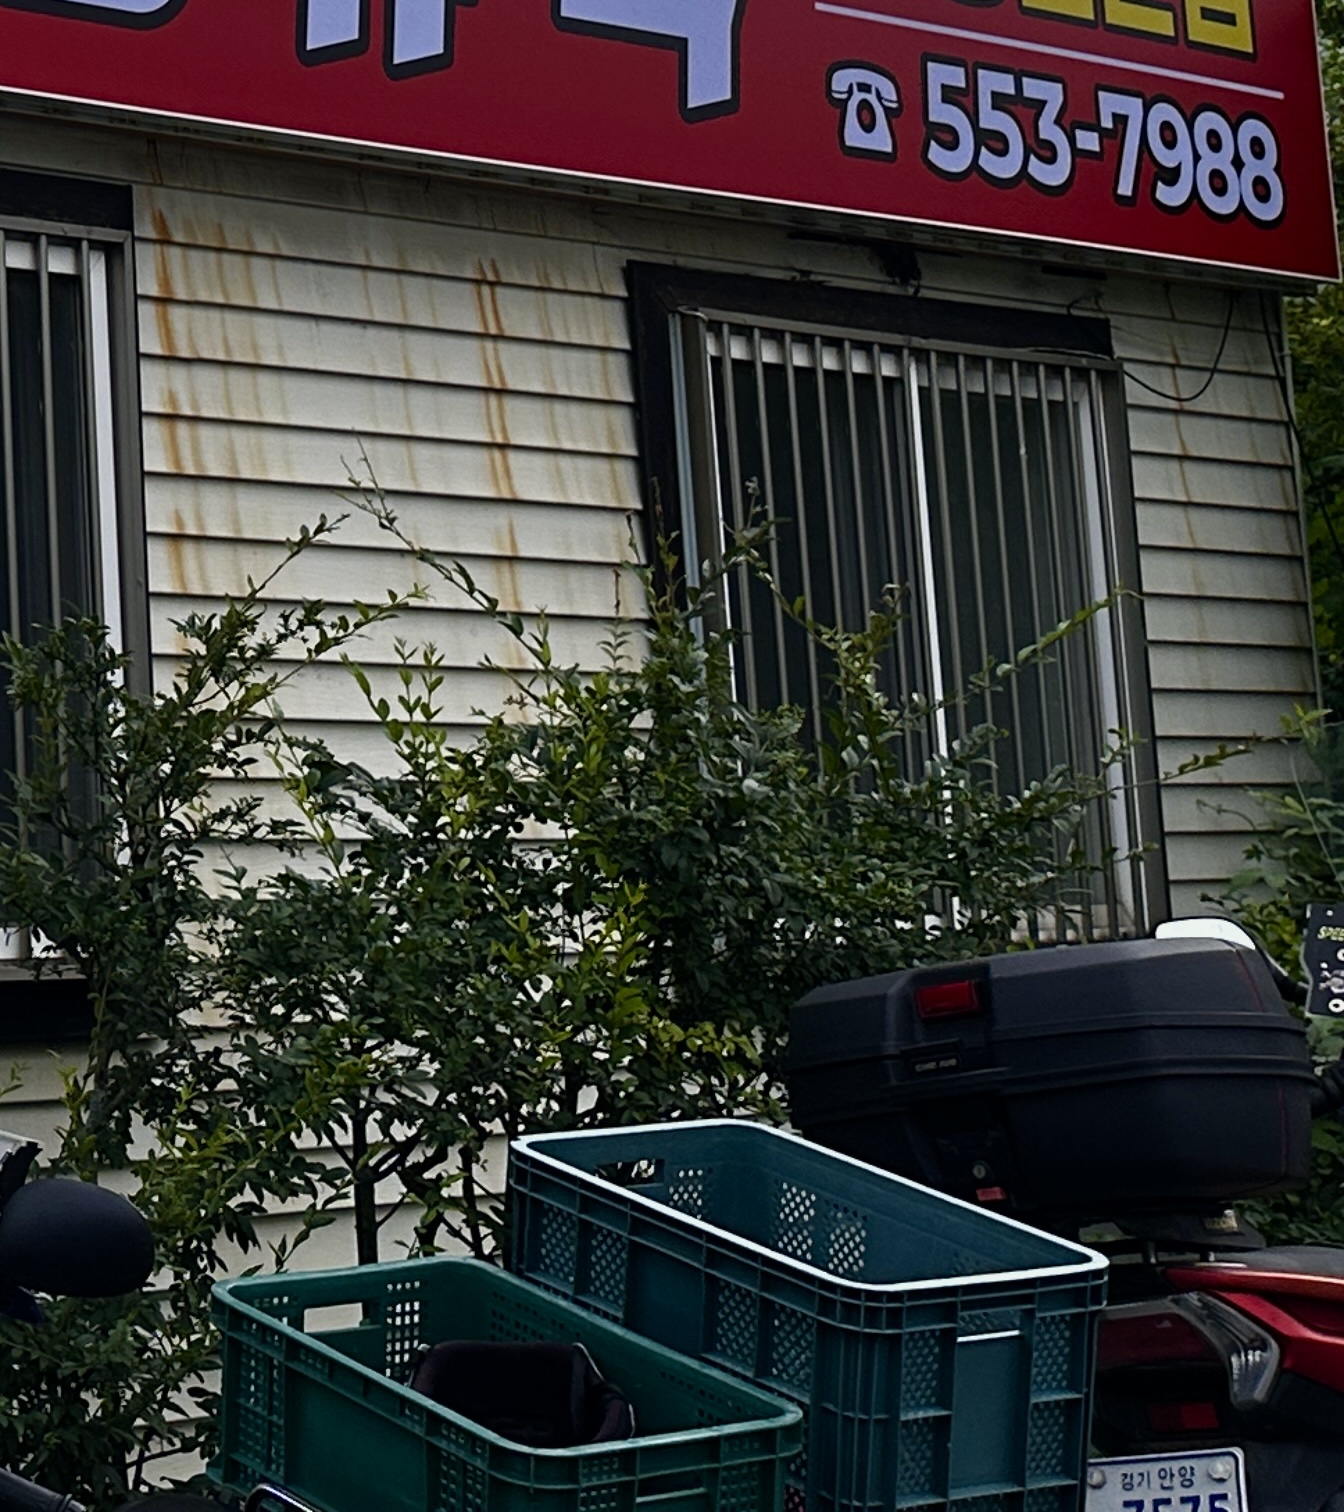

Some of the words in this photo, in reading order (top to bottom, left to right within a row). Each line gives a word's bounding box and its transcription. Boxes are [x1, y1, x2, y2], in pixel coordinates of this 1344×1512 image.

[925, 60, 1285, 222] 553-7988
[1121, 1470, 1151, 1491] 경기
[1157, 1464, 1196, 1491] 안양
